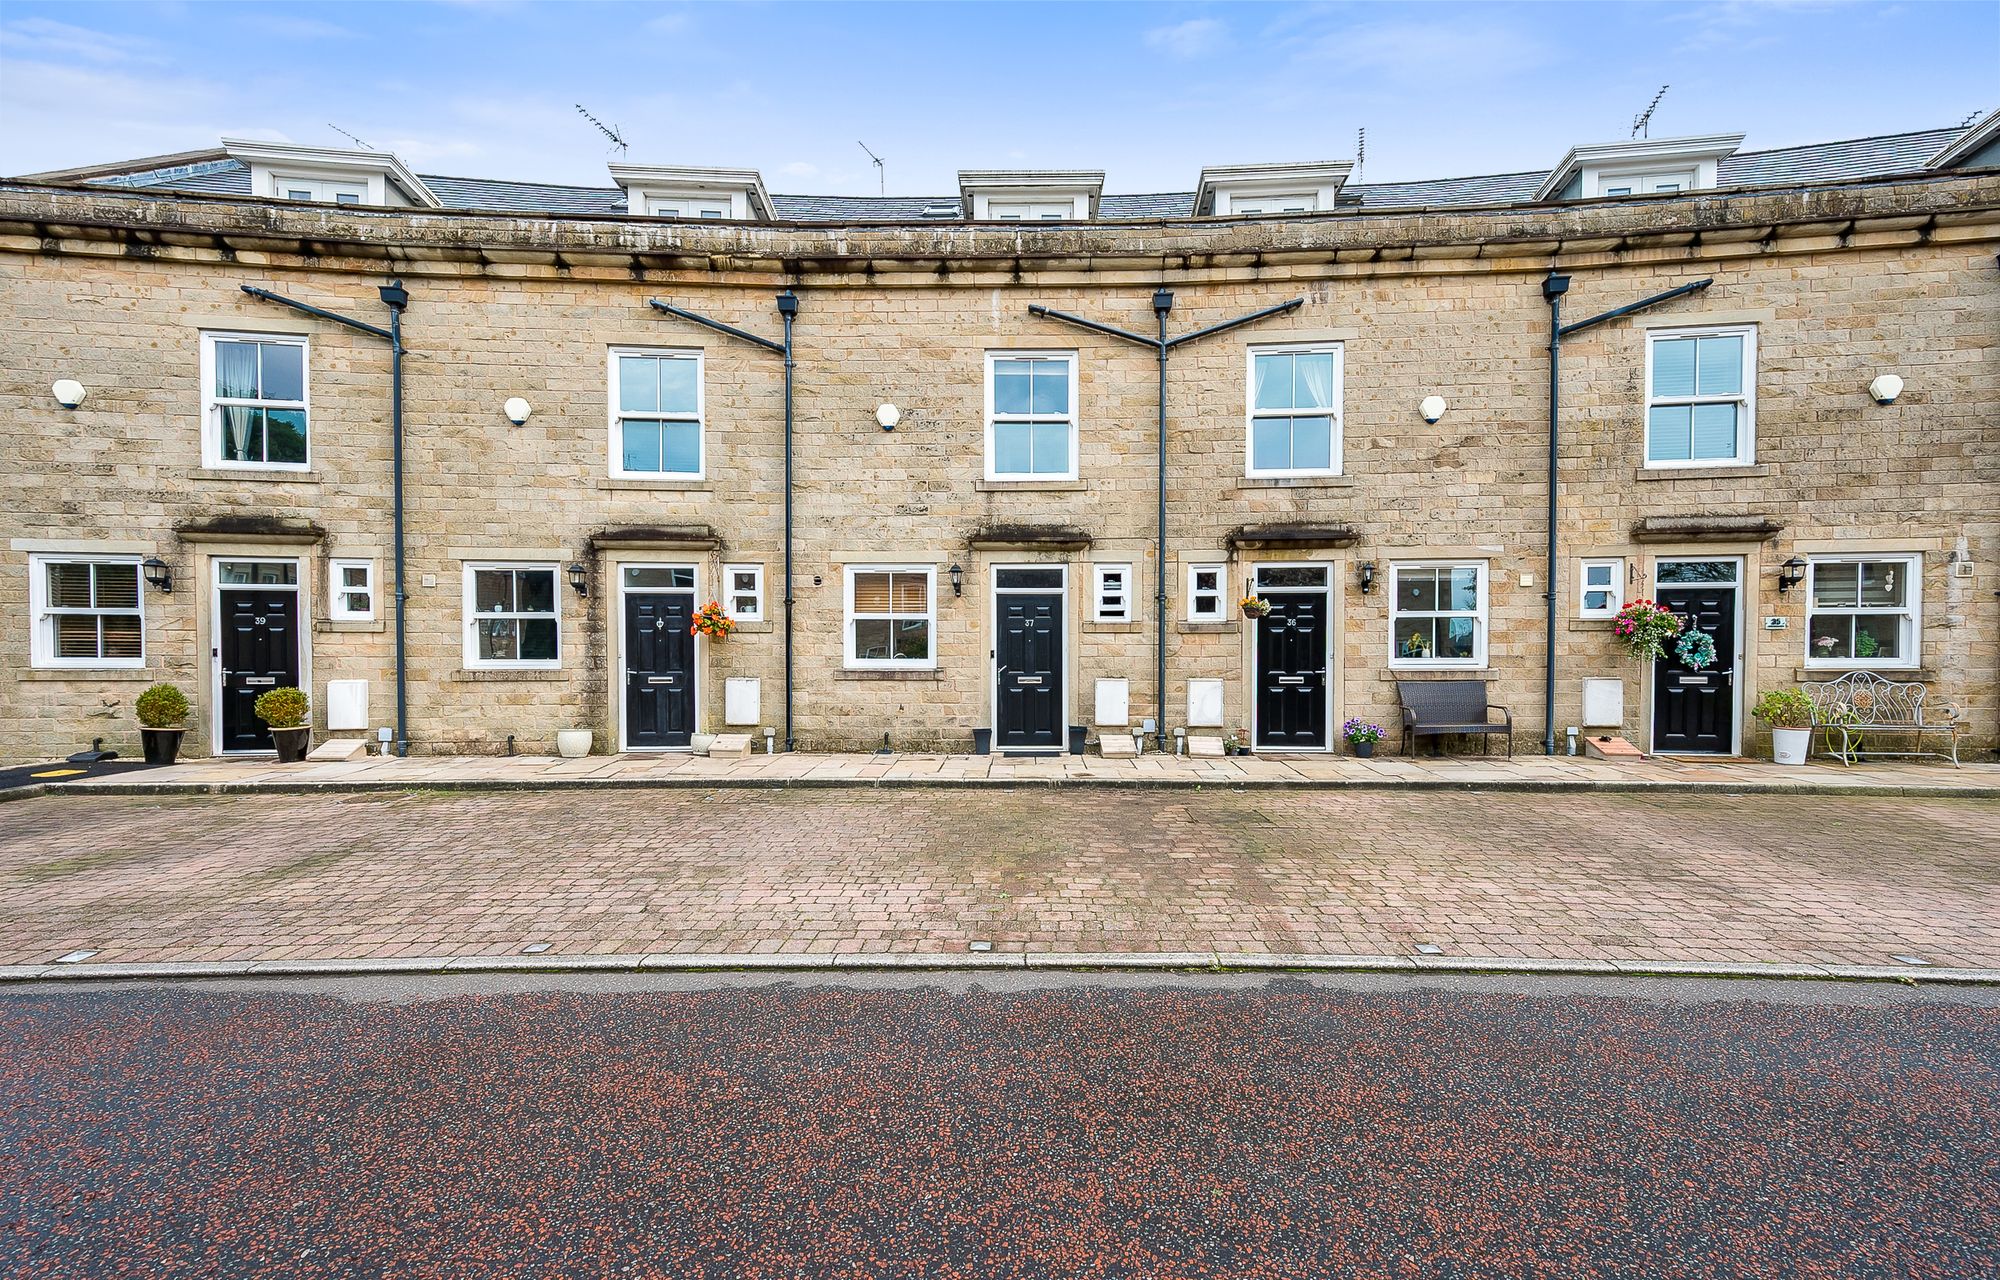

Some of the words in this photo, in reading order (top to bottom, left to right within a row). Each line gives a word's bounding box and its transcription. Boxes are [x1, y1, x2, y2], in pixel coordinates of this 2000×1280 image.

[254, 616, 267, 625] 39
[1024, 619, 1035, 627] 37
[1286, 618, 1297, 627] 36
